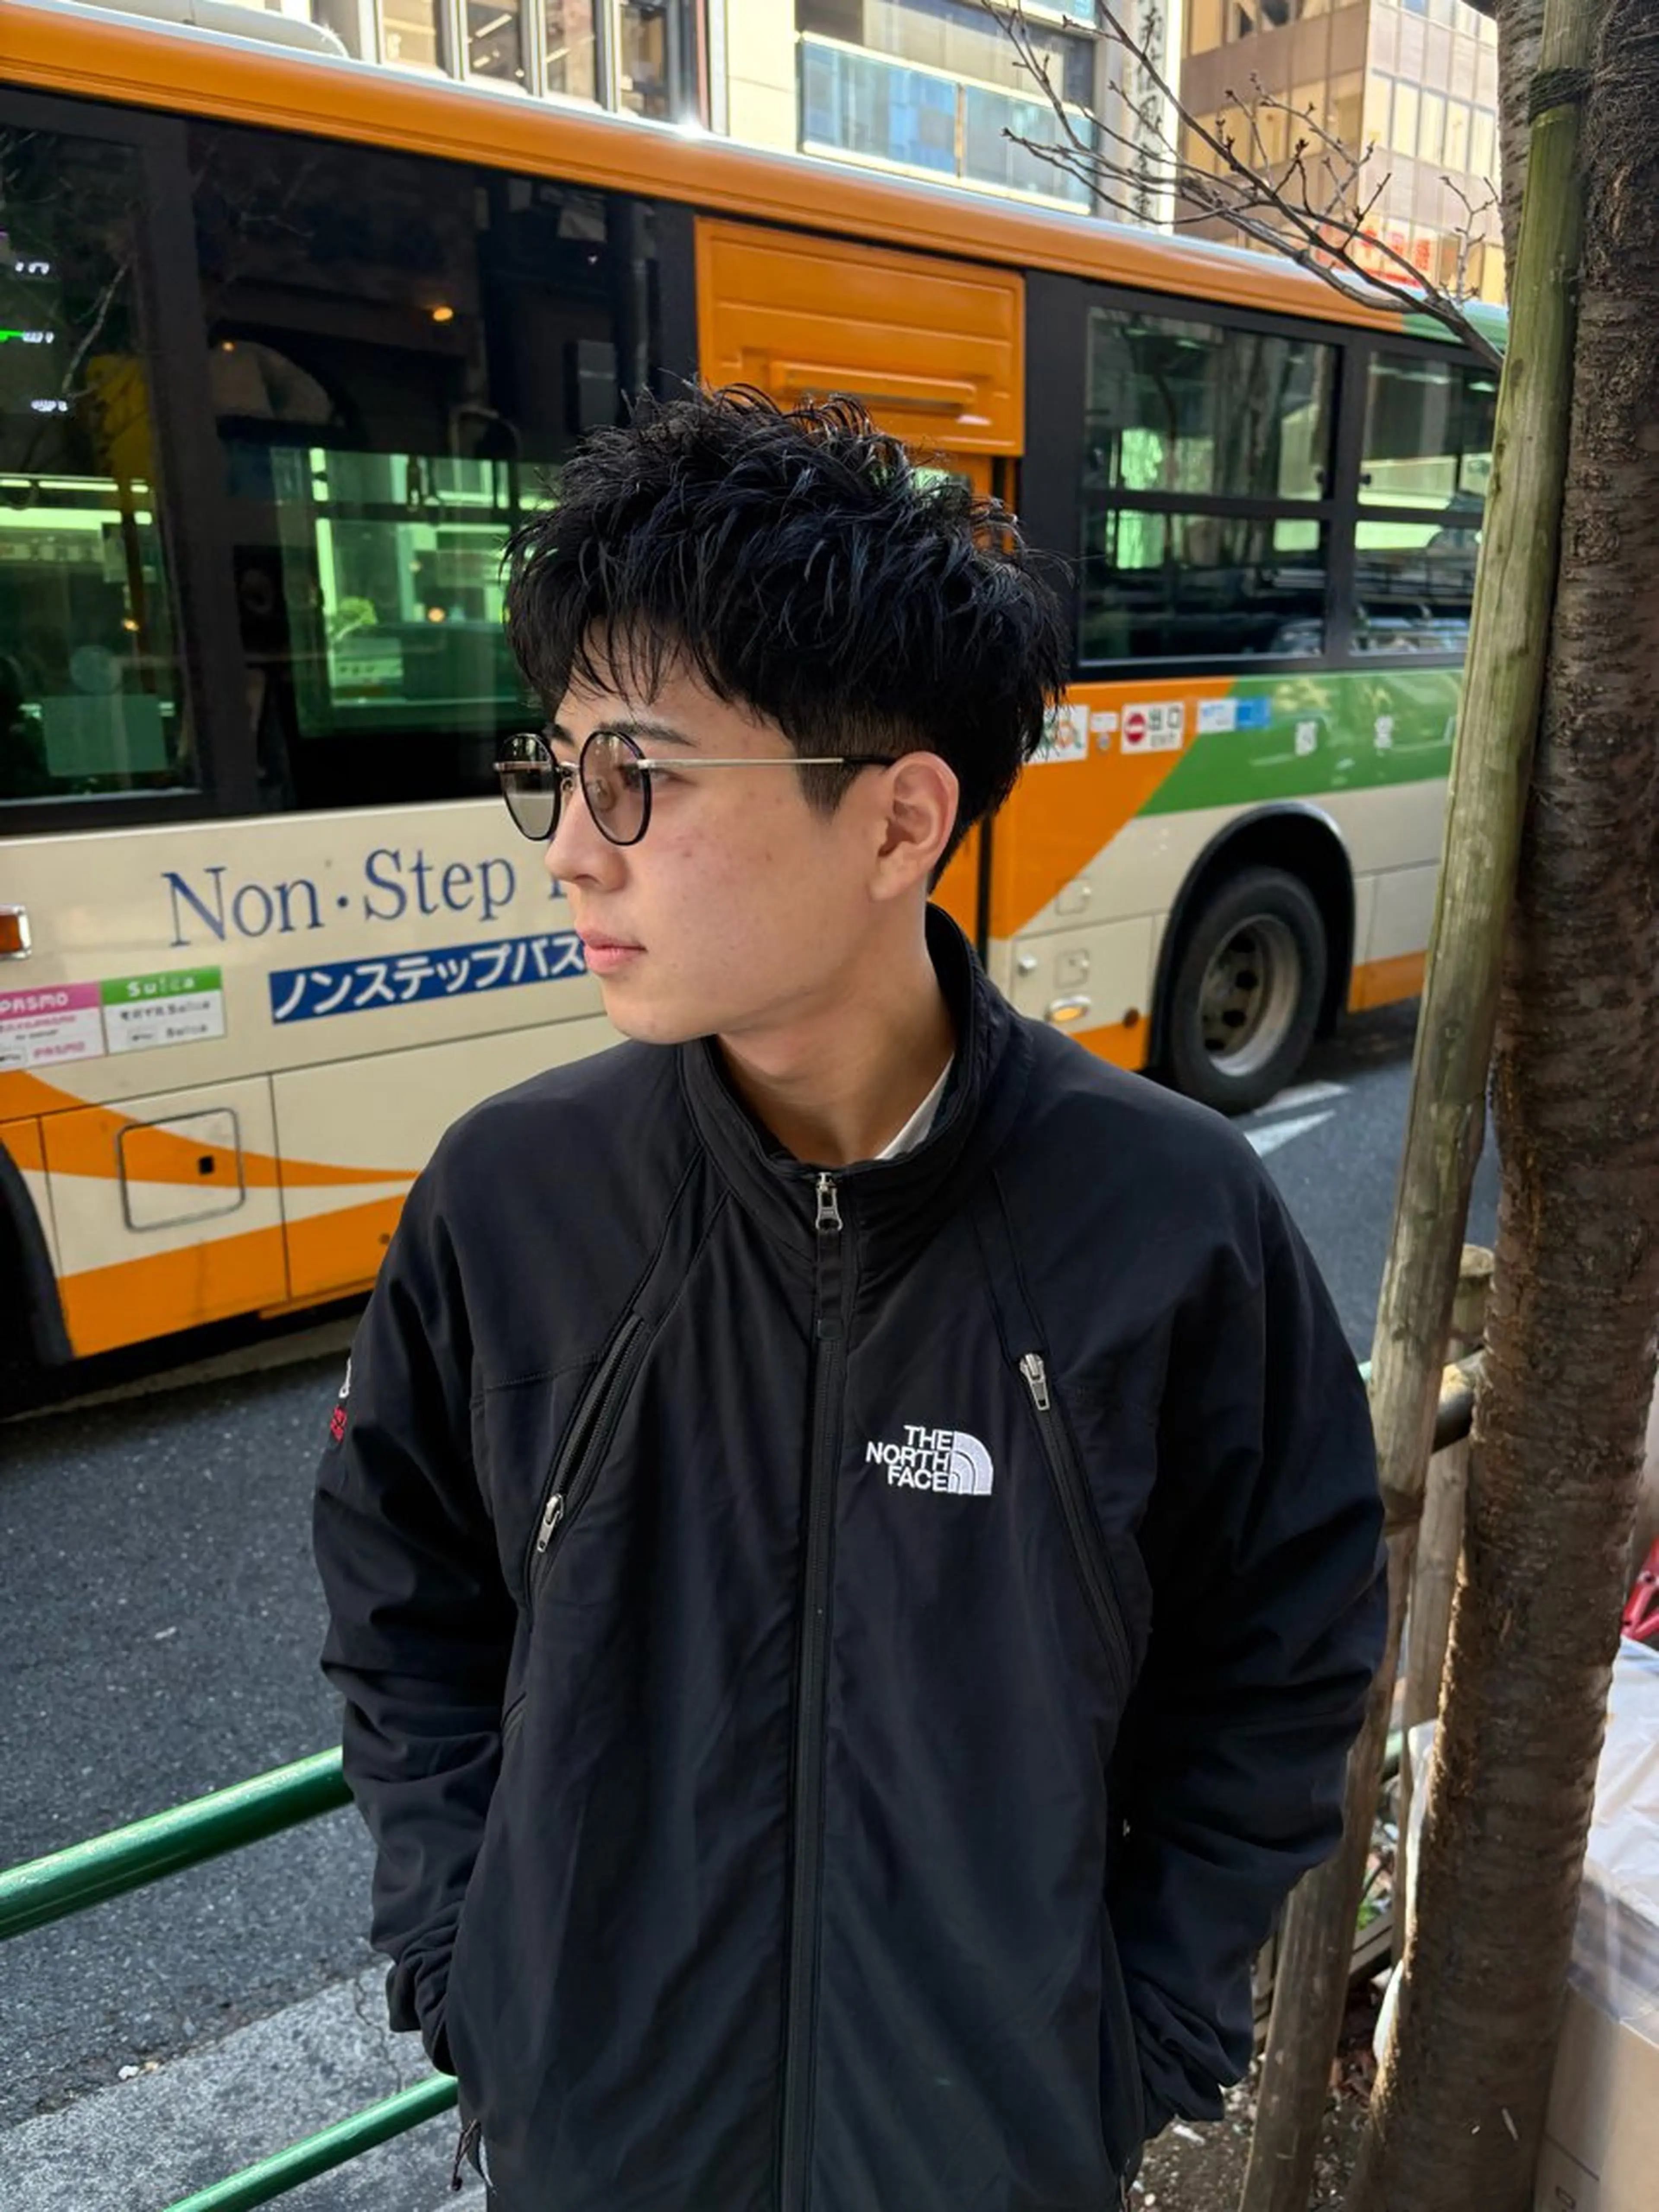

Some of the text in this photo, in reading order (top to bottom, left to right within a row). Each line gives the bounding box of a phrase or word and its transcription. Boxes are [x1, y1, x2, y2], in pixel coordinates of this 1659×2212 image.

[275, 936, 585, 1020] ノンステップバス
[903, 1424, 952, 1451] THE
[866, 1441, 950, 1471] NORTH
[887, 1465, 949, 1492] FACE
